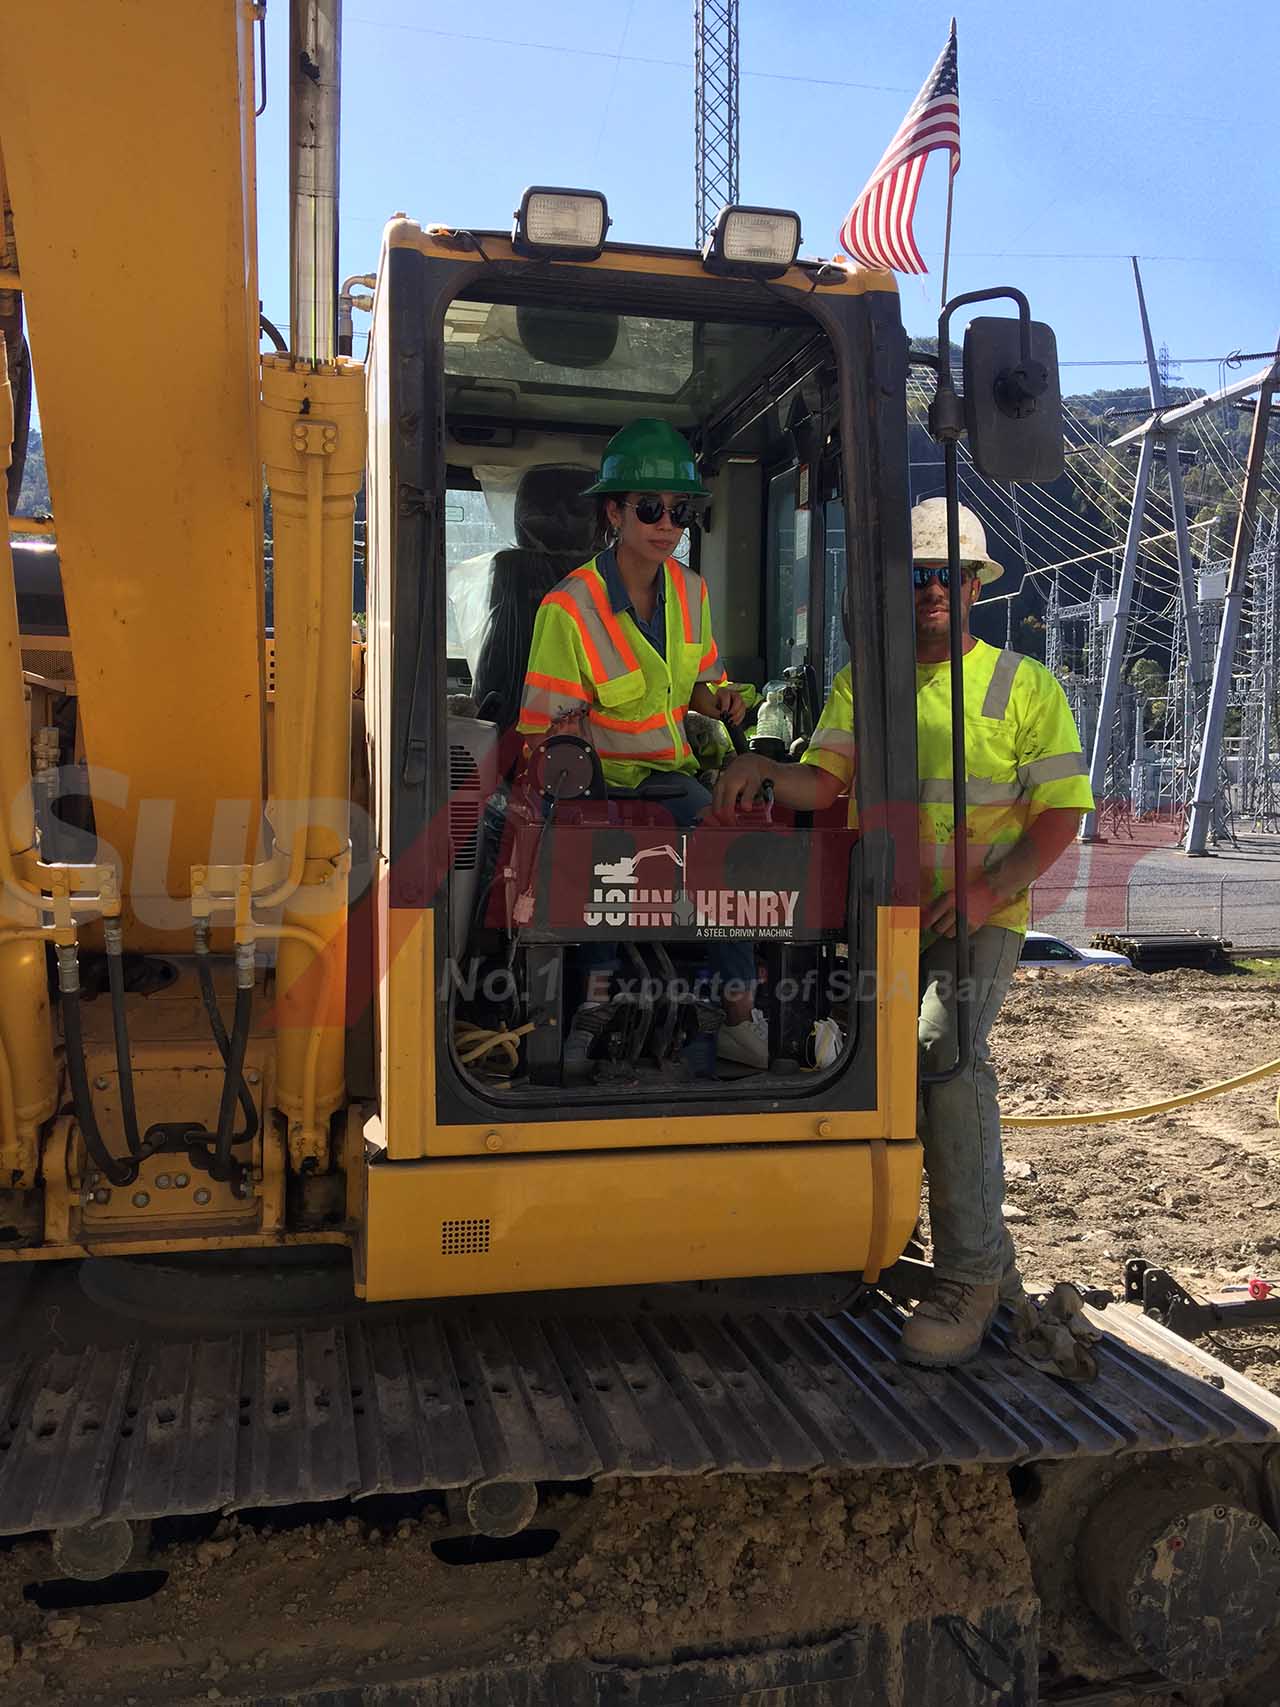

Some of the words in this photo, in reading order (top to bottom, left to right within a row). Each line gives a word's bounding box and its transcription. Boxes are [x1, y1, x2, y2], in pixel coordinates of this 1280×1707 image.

[583, 889, 673, 927] JOHN
[696, 890, 800, 927] HENRY
[696, 928, 703, 937] A
[703, 928, 727, 937] STEEL
[729, 928, 757, 937] DRIVIN'
[758, 928, 793, 937] MACHINE
